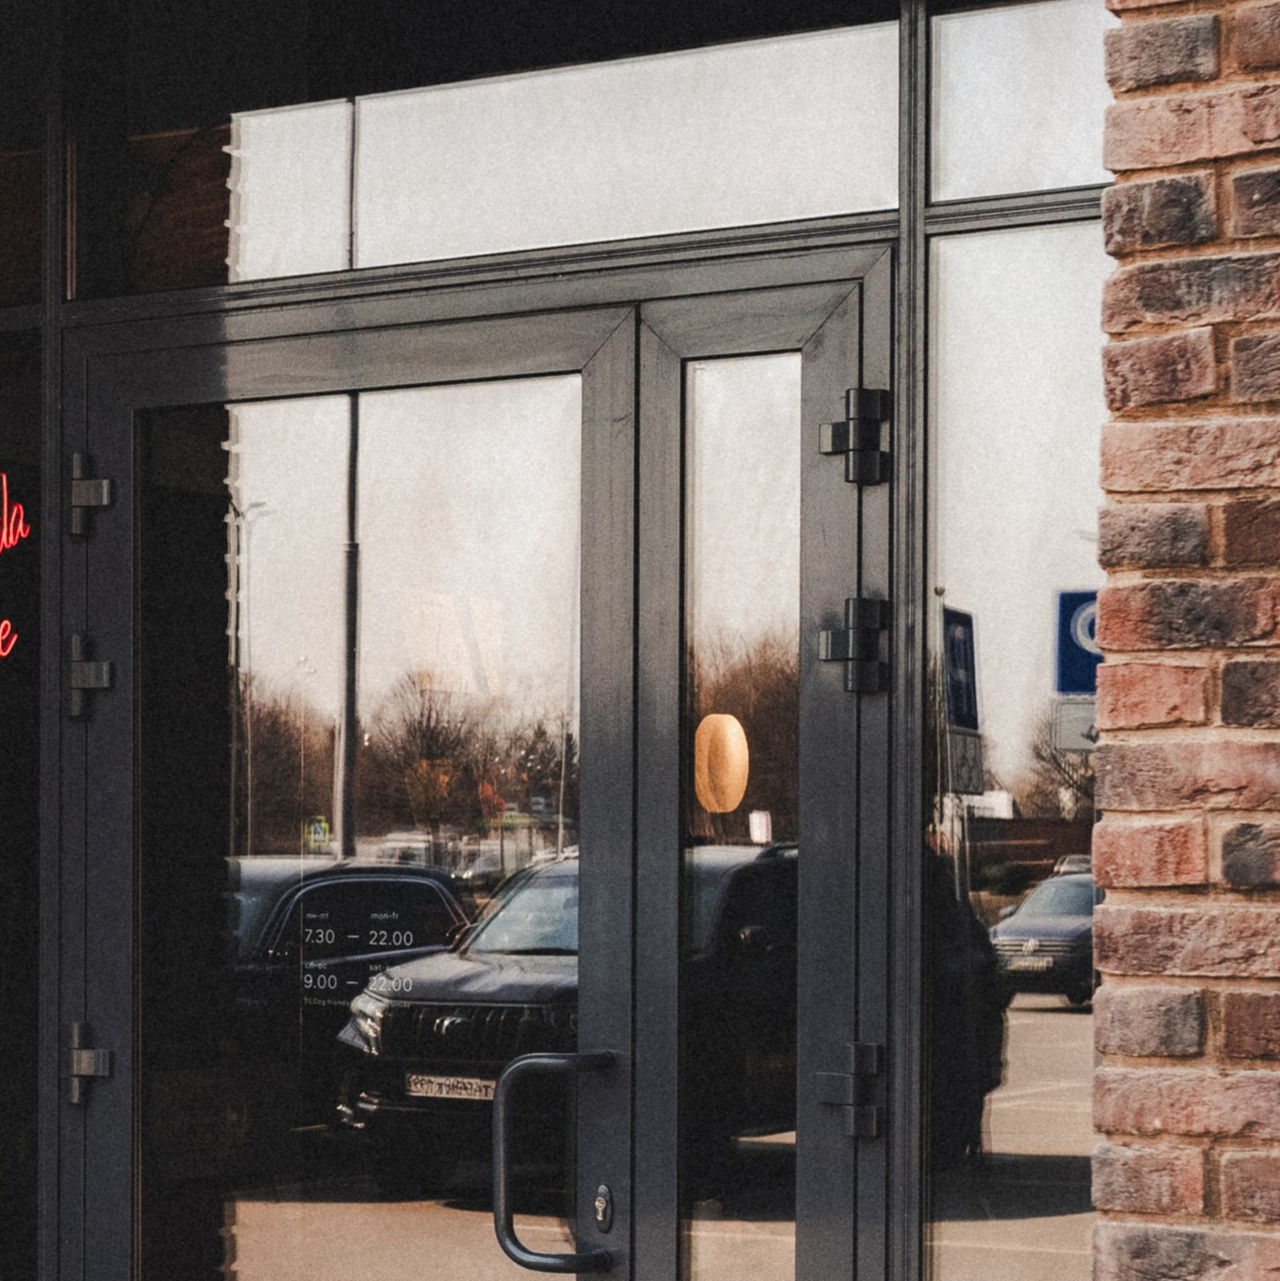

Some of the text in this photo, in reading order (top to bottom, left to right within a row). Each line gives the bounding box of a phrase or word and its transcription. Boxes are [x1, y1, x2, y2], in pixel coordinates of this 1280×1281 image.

[304, 928, 336, 945] 7.30
[368, 930, 414, 947] 22.00
[303, 973, 338, 990] 9.00
[368, 976, 413, 992] 22.00
